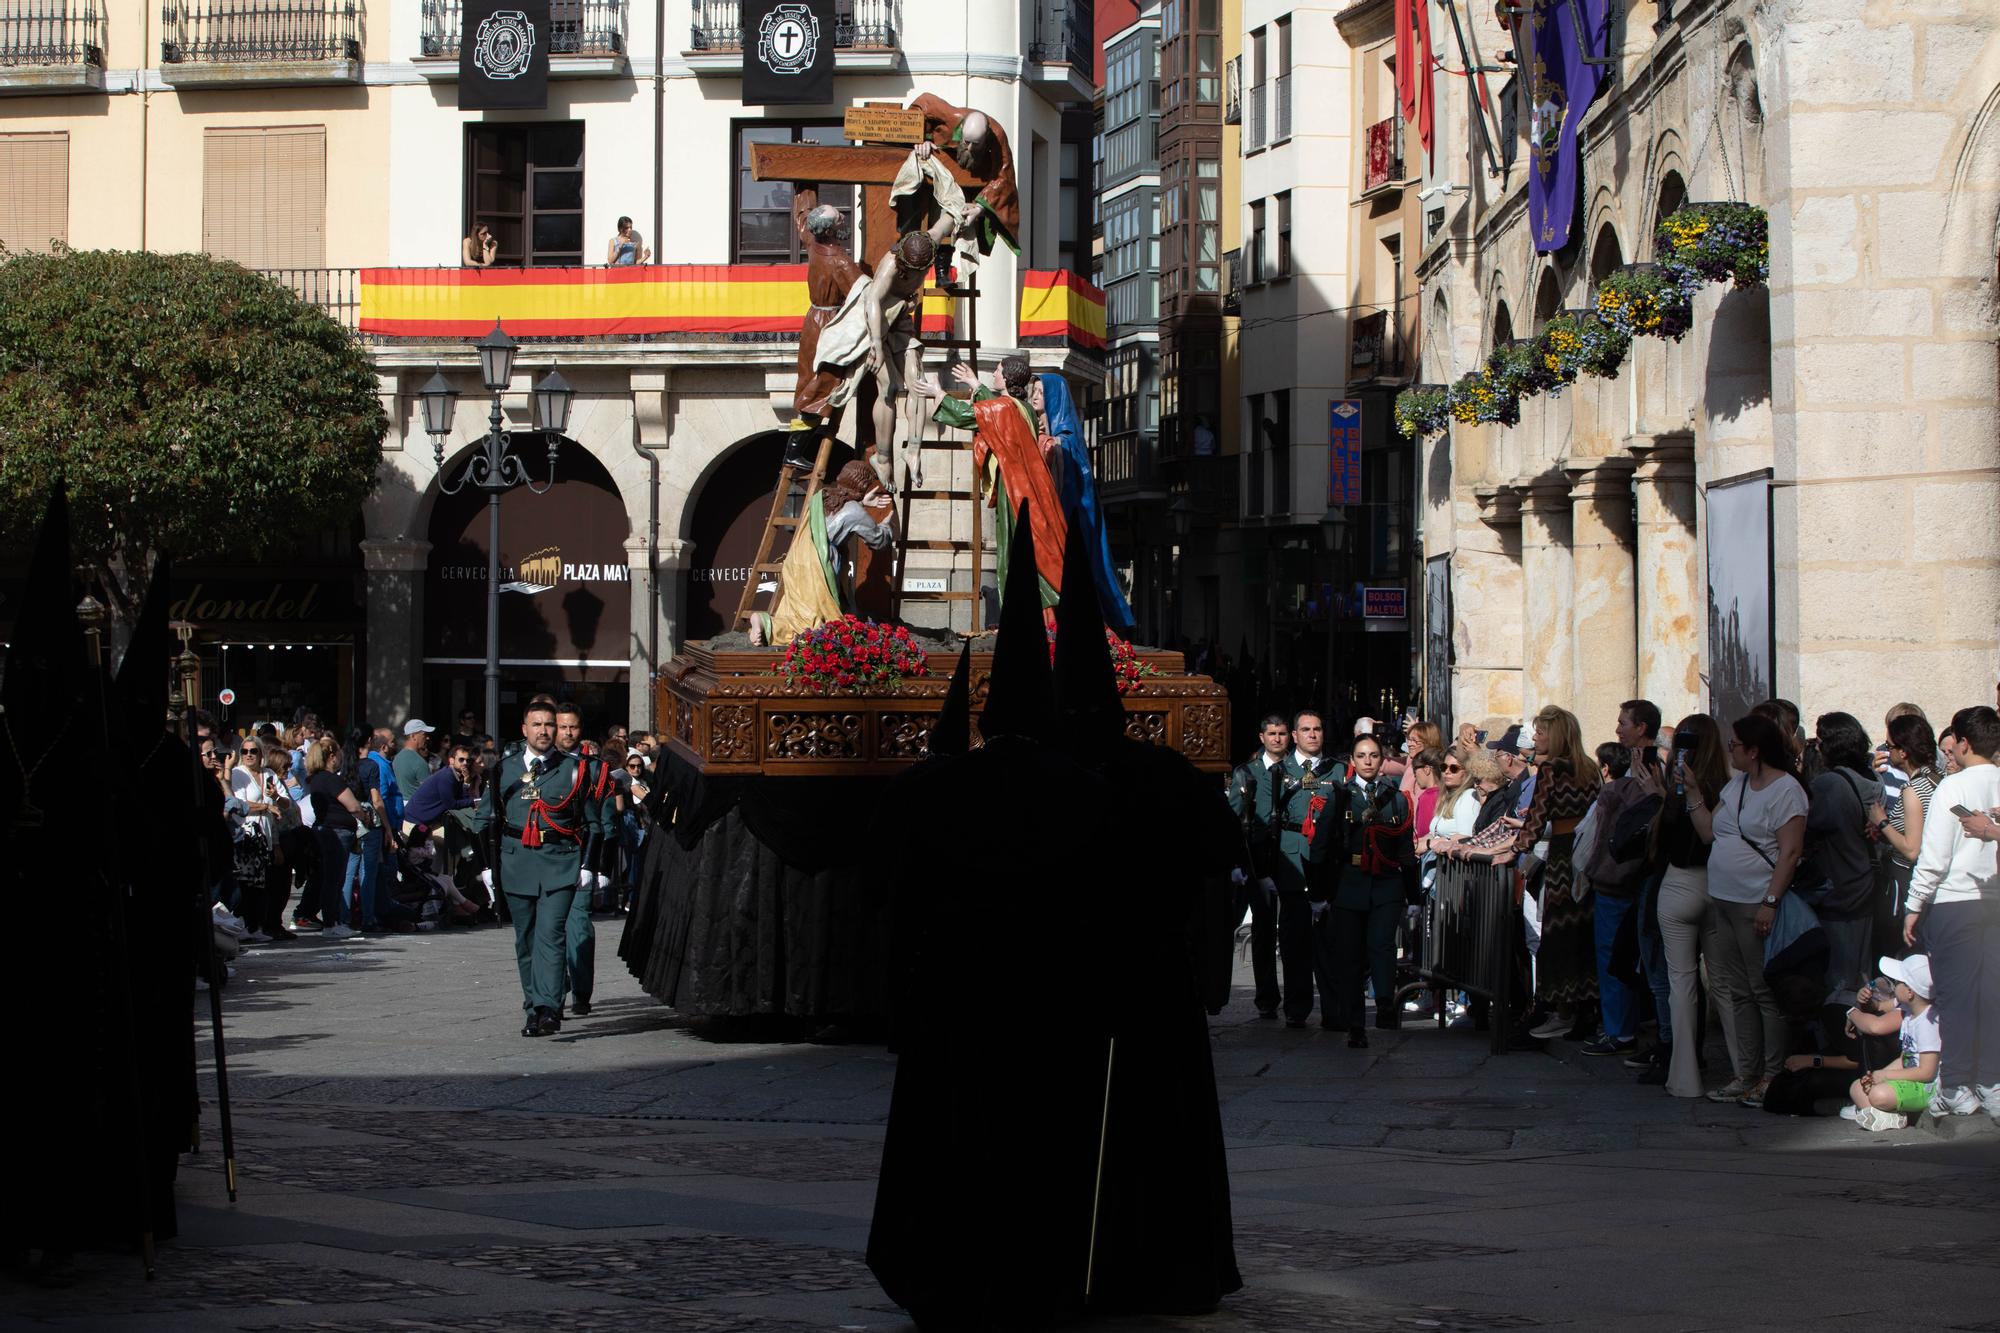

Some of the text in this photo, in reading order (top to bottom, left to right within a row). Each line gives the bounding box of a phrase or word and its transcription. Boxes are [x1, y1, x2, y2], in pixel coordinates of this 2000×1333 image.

[1333, 428, 1345, 503] MALETAS
[1347, 428, 1359, 503] BOLSOS
[563, 563, 600, 581] PLAZA
[916, 581, 942, 589] PLAZA
[1368, 592, 1402, 602] BOLSOS
[1366, 604, 1404, 616] MALETAS
